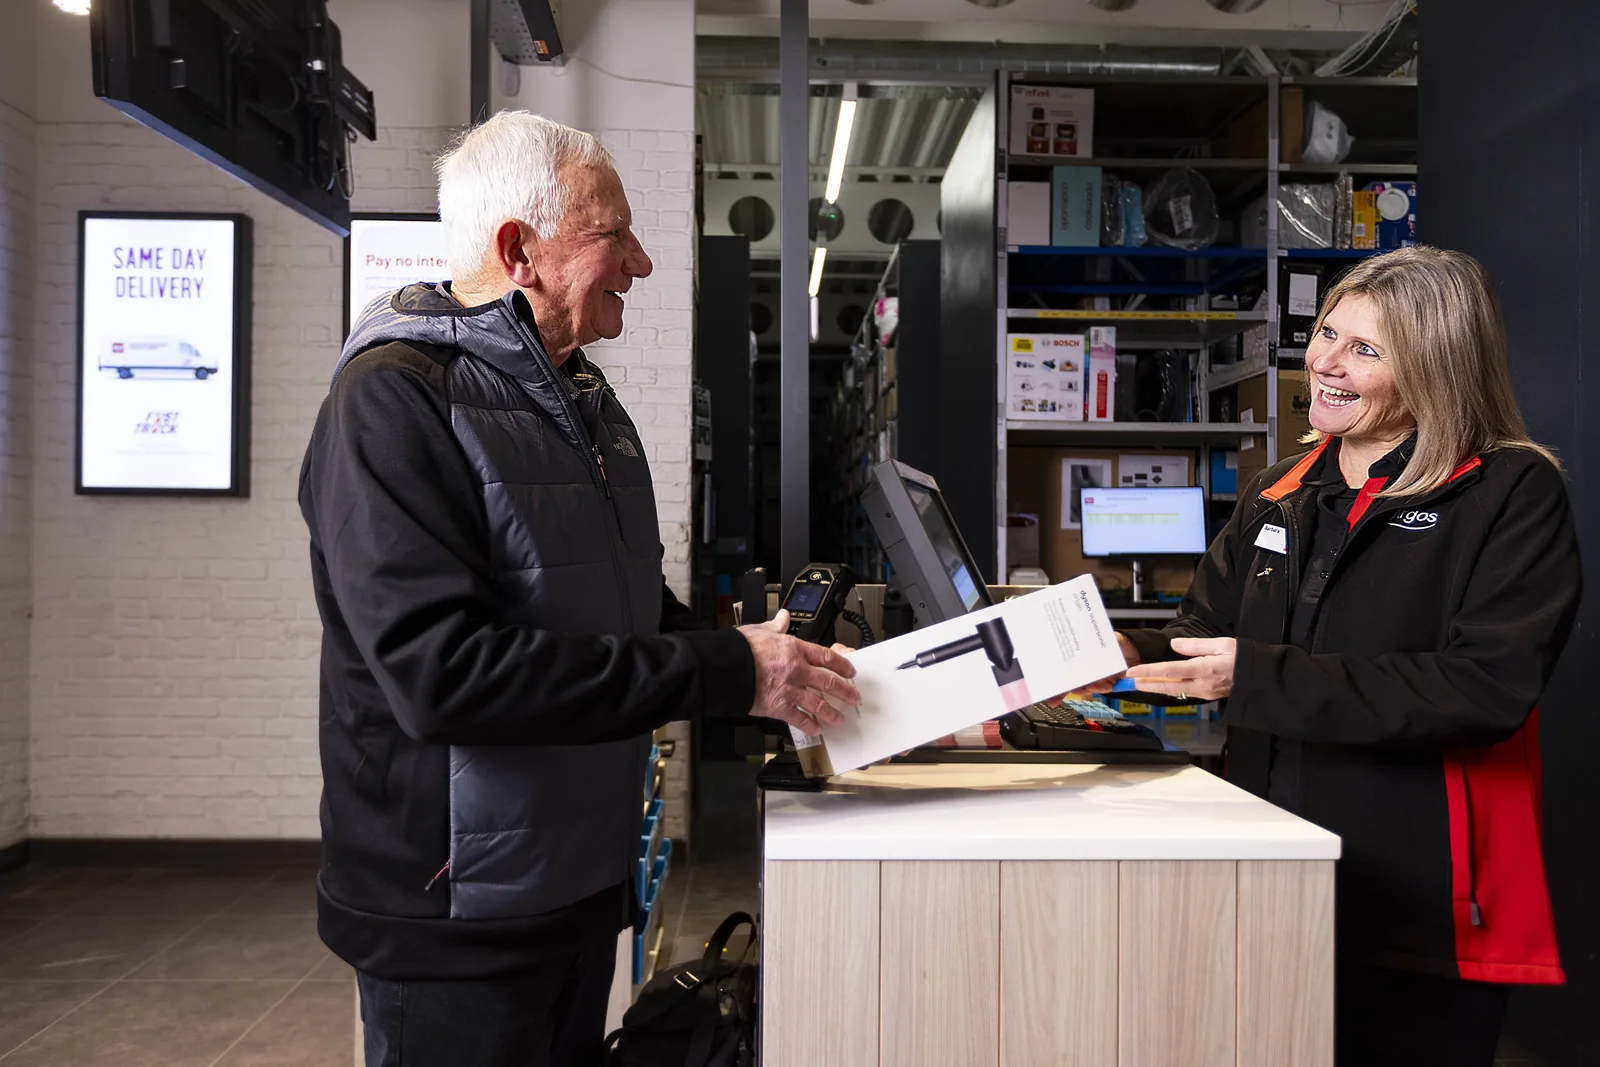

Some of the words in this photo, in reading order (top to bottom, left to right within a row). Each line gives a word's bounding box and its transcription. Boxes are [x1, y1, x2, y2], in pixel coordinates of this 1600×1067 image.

[113, 246, 165, 270] SAME
[172, 247, 207, 270] DAY
[366, 254, 391, 269] Pay
[395, 257, 413, 267] no
[116, 276, 204, 299] DELIVERY
[134, 422, 178, 434] TRACK
[1072, 592, 1083, 612] origin
[1080, 590, 1091, 612] dyson
[1089, 613, 1106, 649] supersonic
